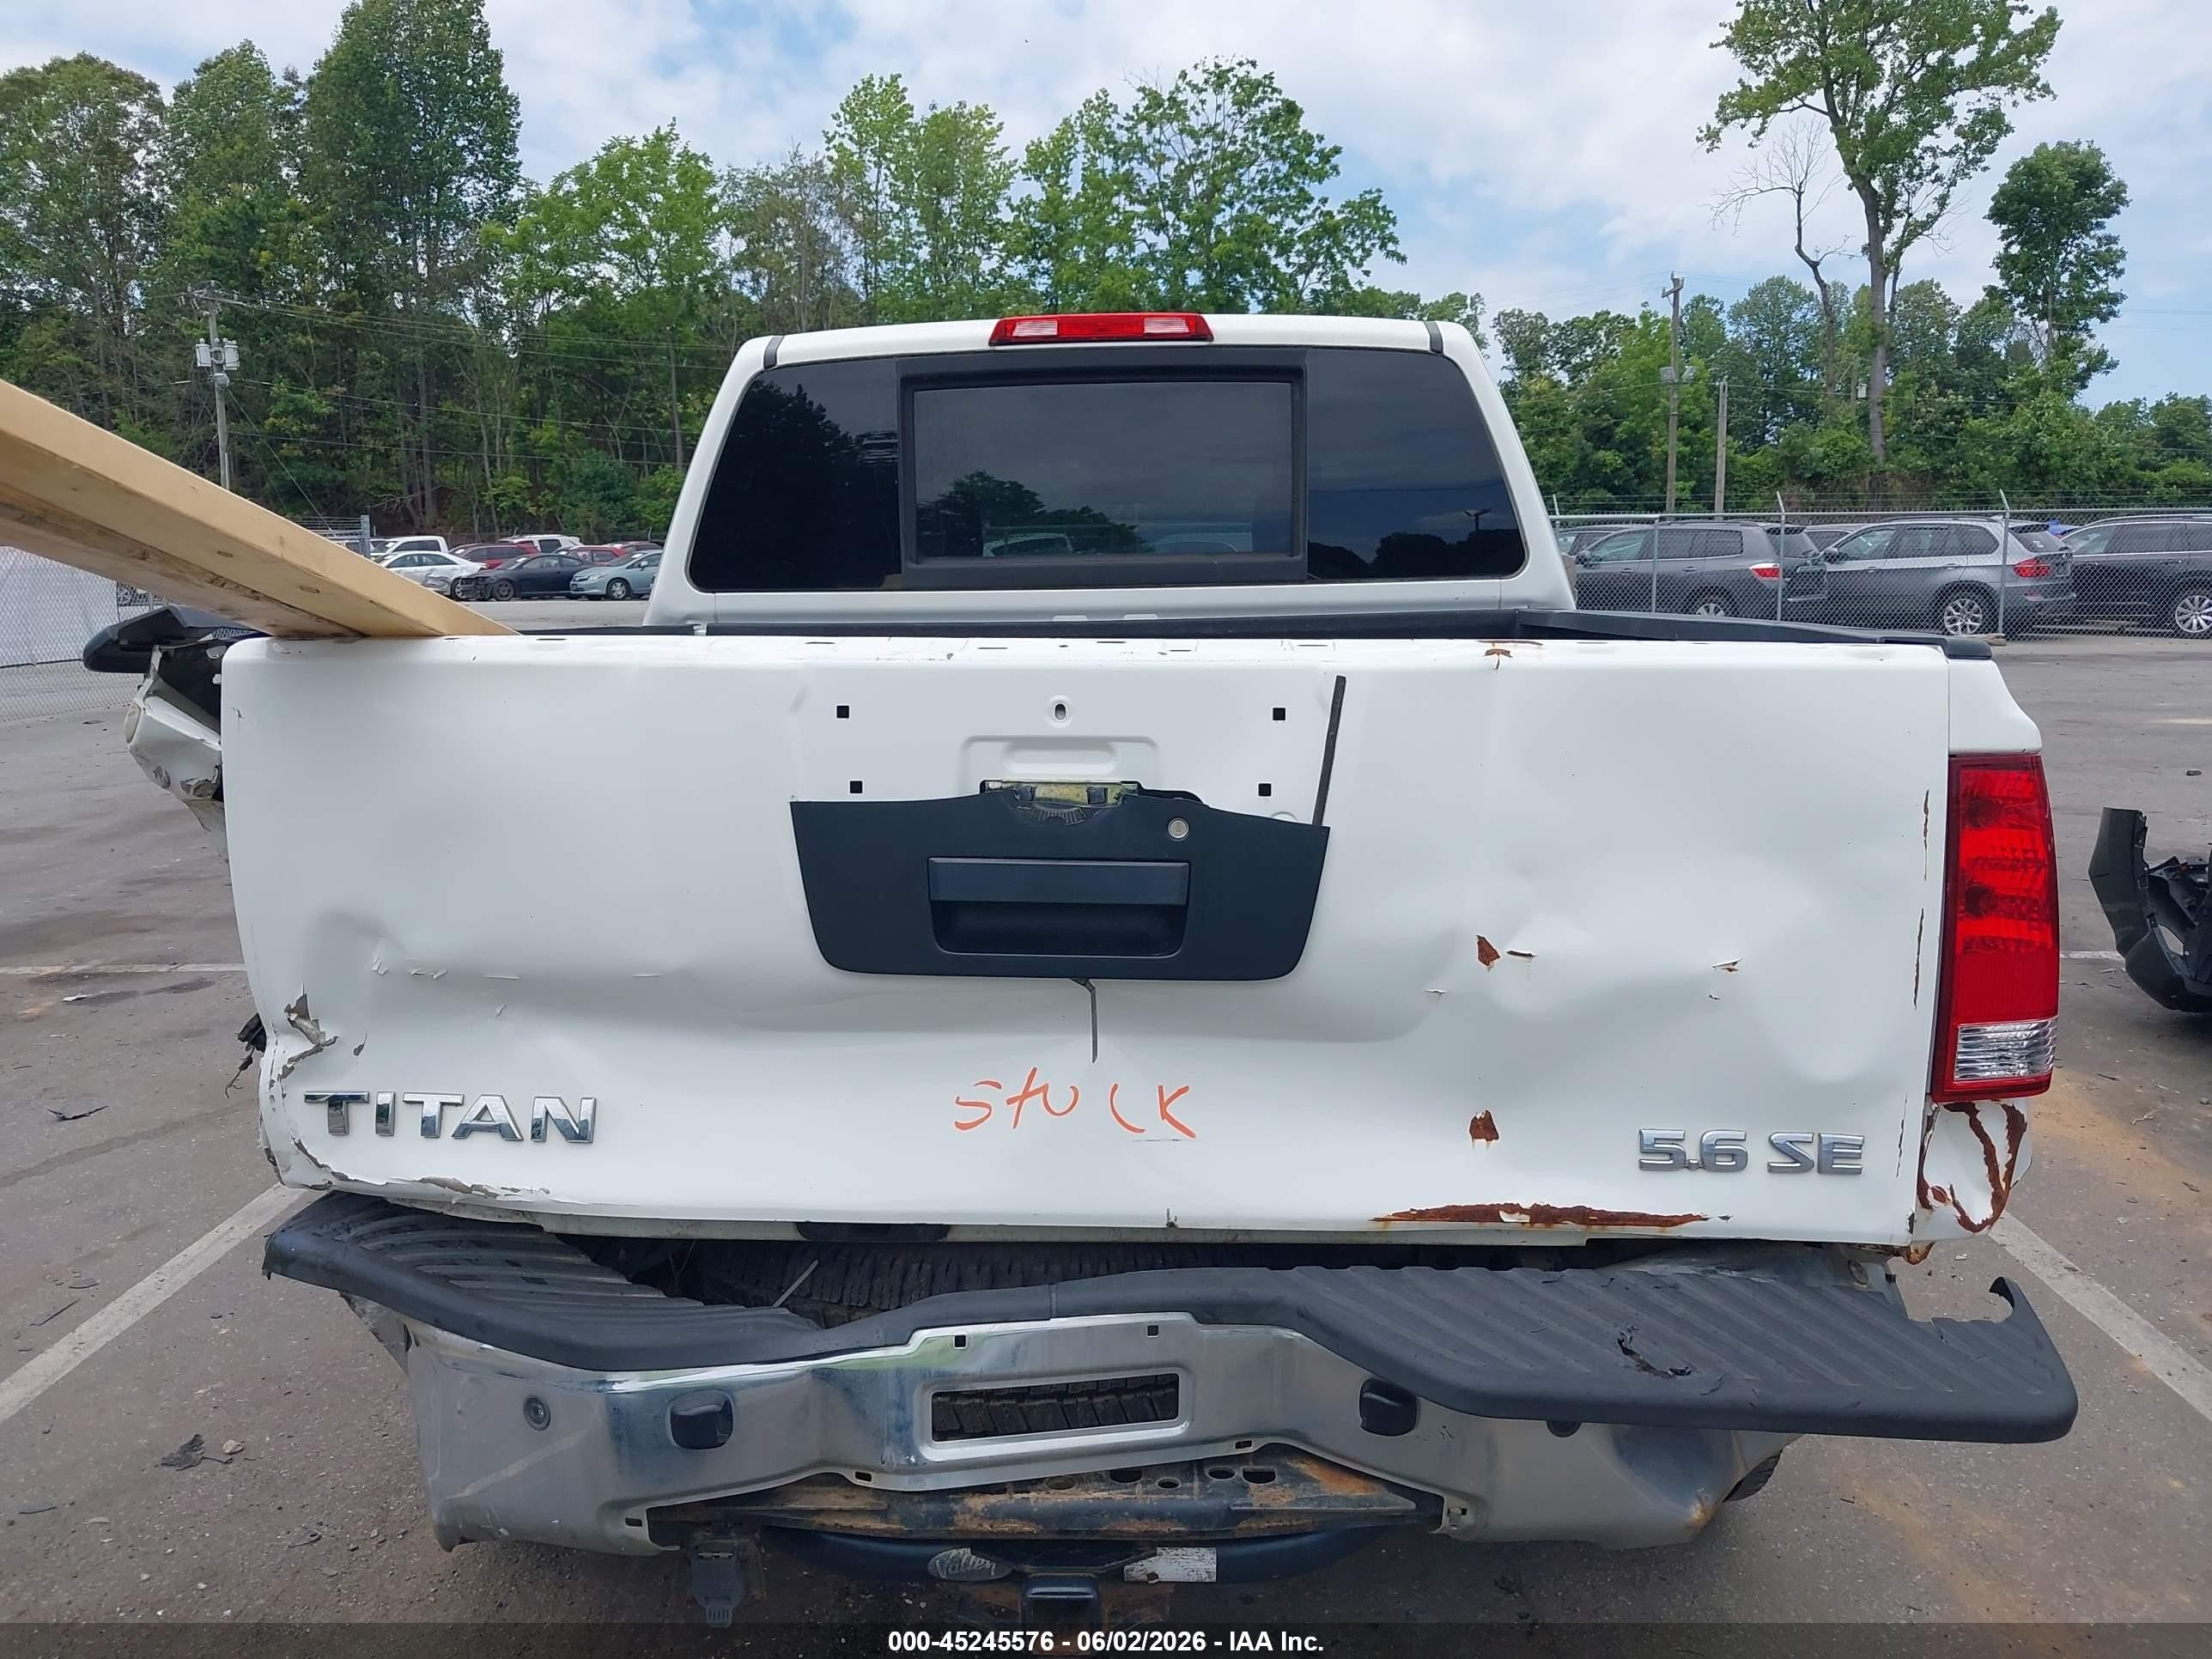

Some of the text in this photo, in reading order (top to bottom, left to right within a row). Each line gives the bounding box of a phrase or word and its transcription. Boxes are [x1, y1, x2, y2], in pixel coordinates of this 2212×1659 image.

[303, 1091, 598, 1144] TITAN
[1638, 1127, 1864, 1175] 5.6 SE
